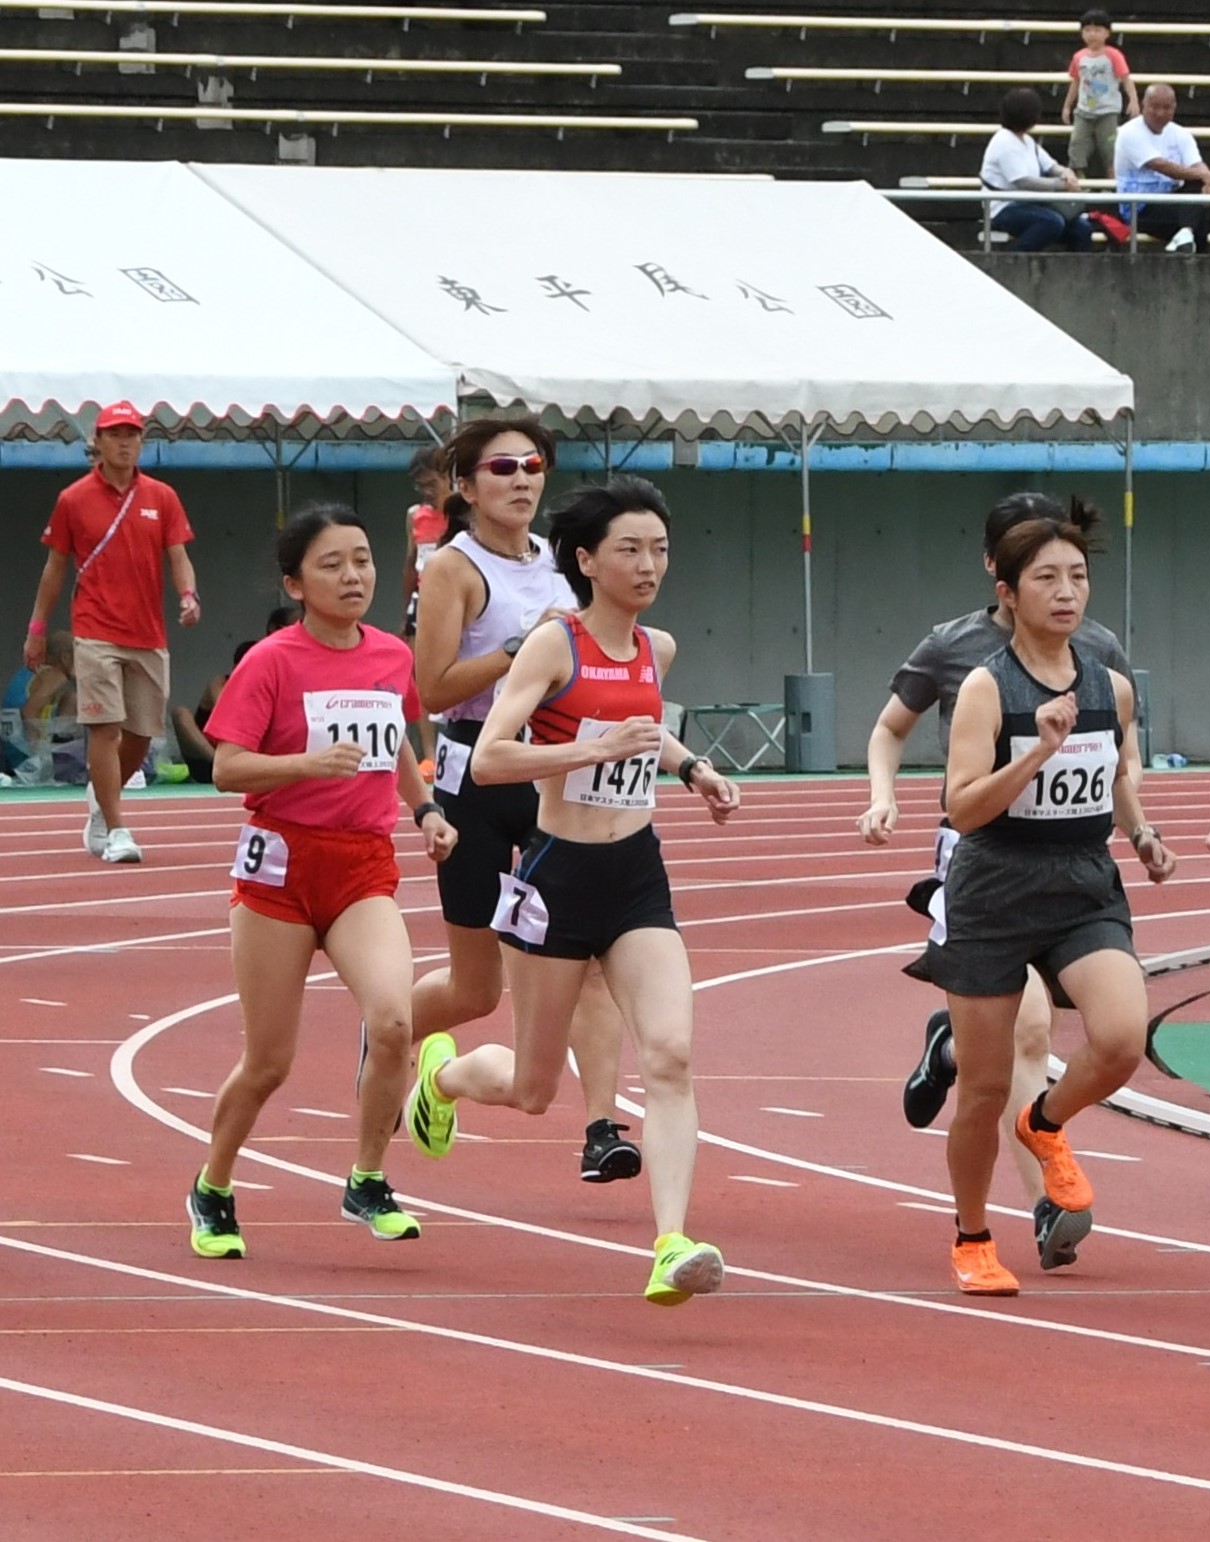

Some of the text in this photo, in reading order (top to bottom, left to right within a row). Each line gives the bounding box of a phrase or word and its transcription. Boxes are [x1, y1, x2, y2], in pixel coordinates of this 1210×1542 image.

[580, 665, 630, 681] OKAYAMA
[327, 722, 398, 758] 1110
[436, 744, 448, 781] 8
[592, 758, 655, 796] 1476
[1032, 765, 1105, 806] 1626
[244, 834, 266, 874] 9
[511, 886, 527, 926] 7
